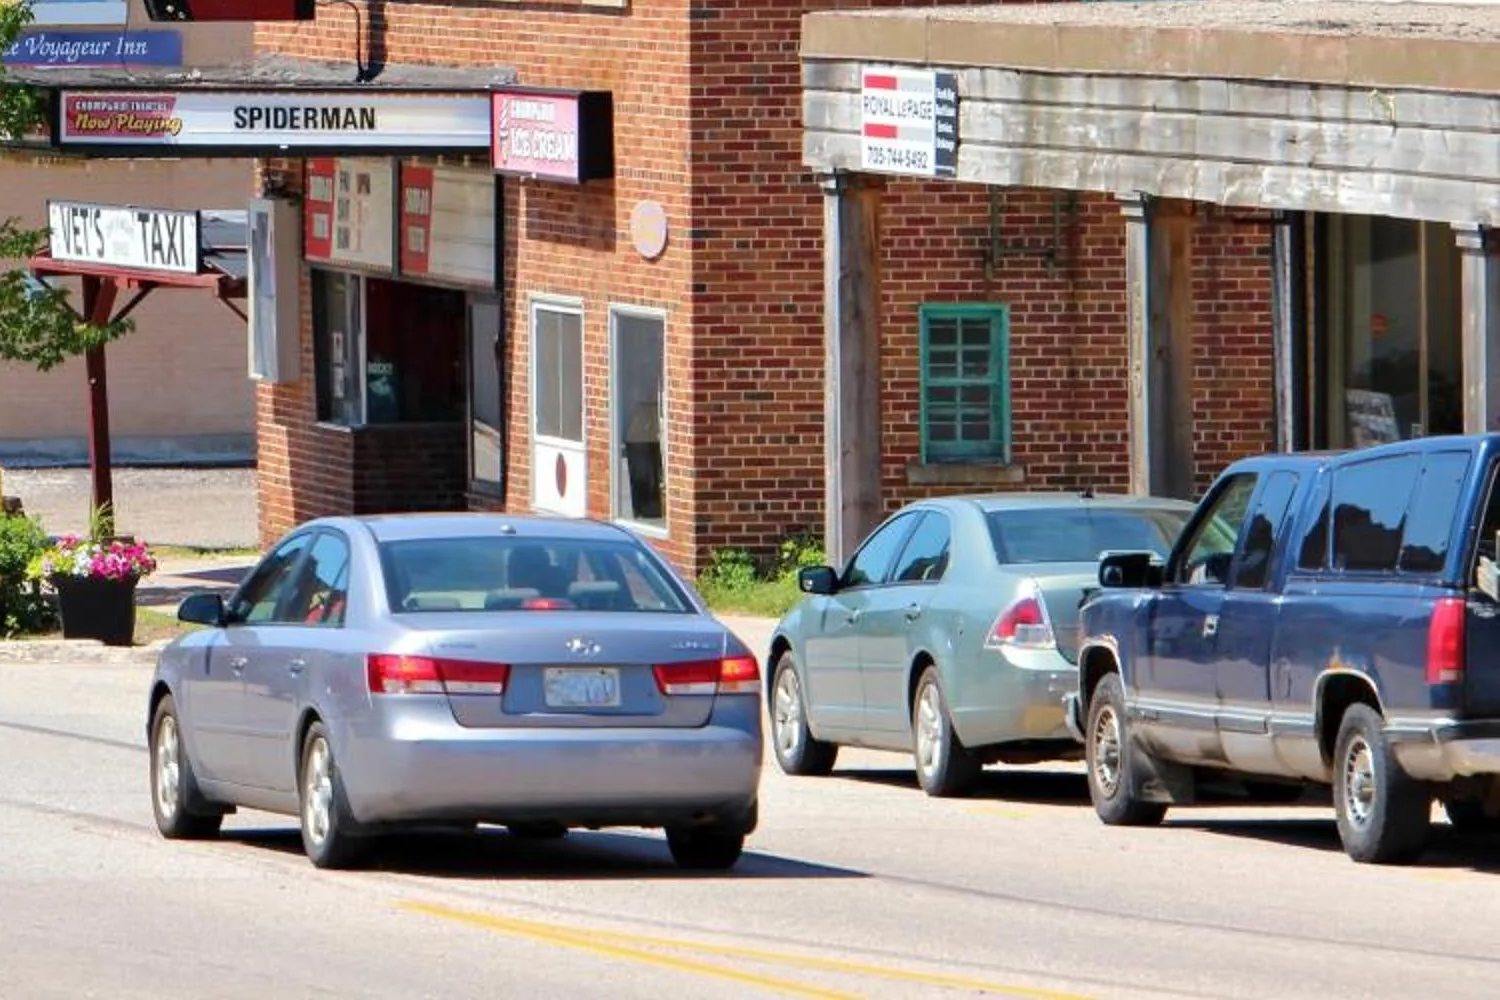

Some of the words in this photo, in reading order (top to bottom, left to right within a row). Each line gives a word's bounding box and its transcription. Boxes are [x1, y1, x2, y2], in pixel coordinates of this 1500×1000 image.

[25, 34, 111, 62] Voyageur
[116, 36, 149, 56] Inn
[234, 105, 376, 130] SPIDERMAN
[863, 95, 895, 117] ROYAL
[75, 112, 112, 130] Now
[115, 112, 184, 137] Playing
[59, 203, 105, 258] VET'S
[137, 210, 186, 267] TAXI
